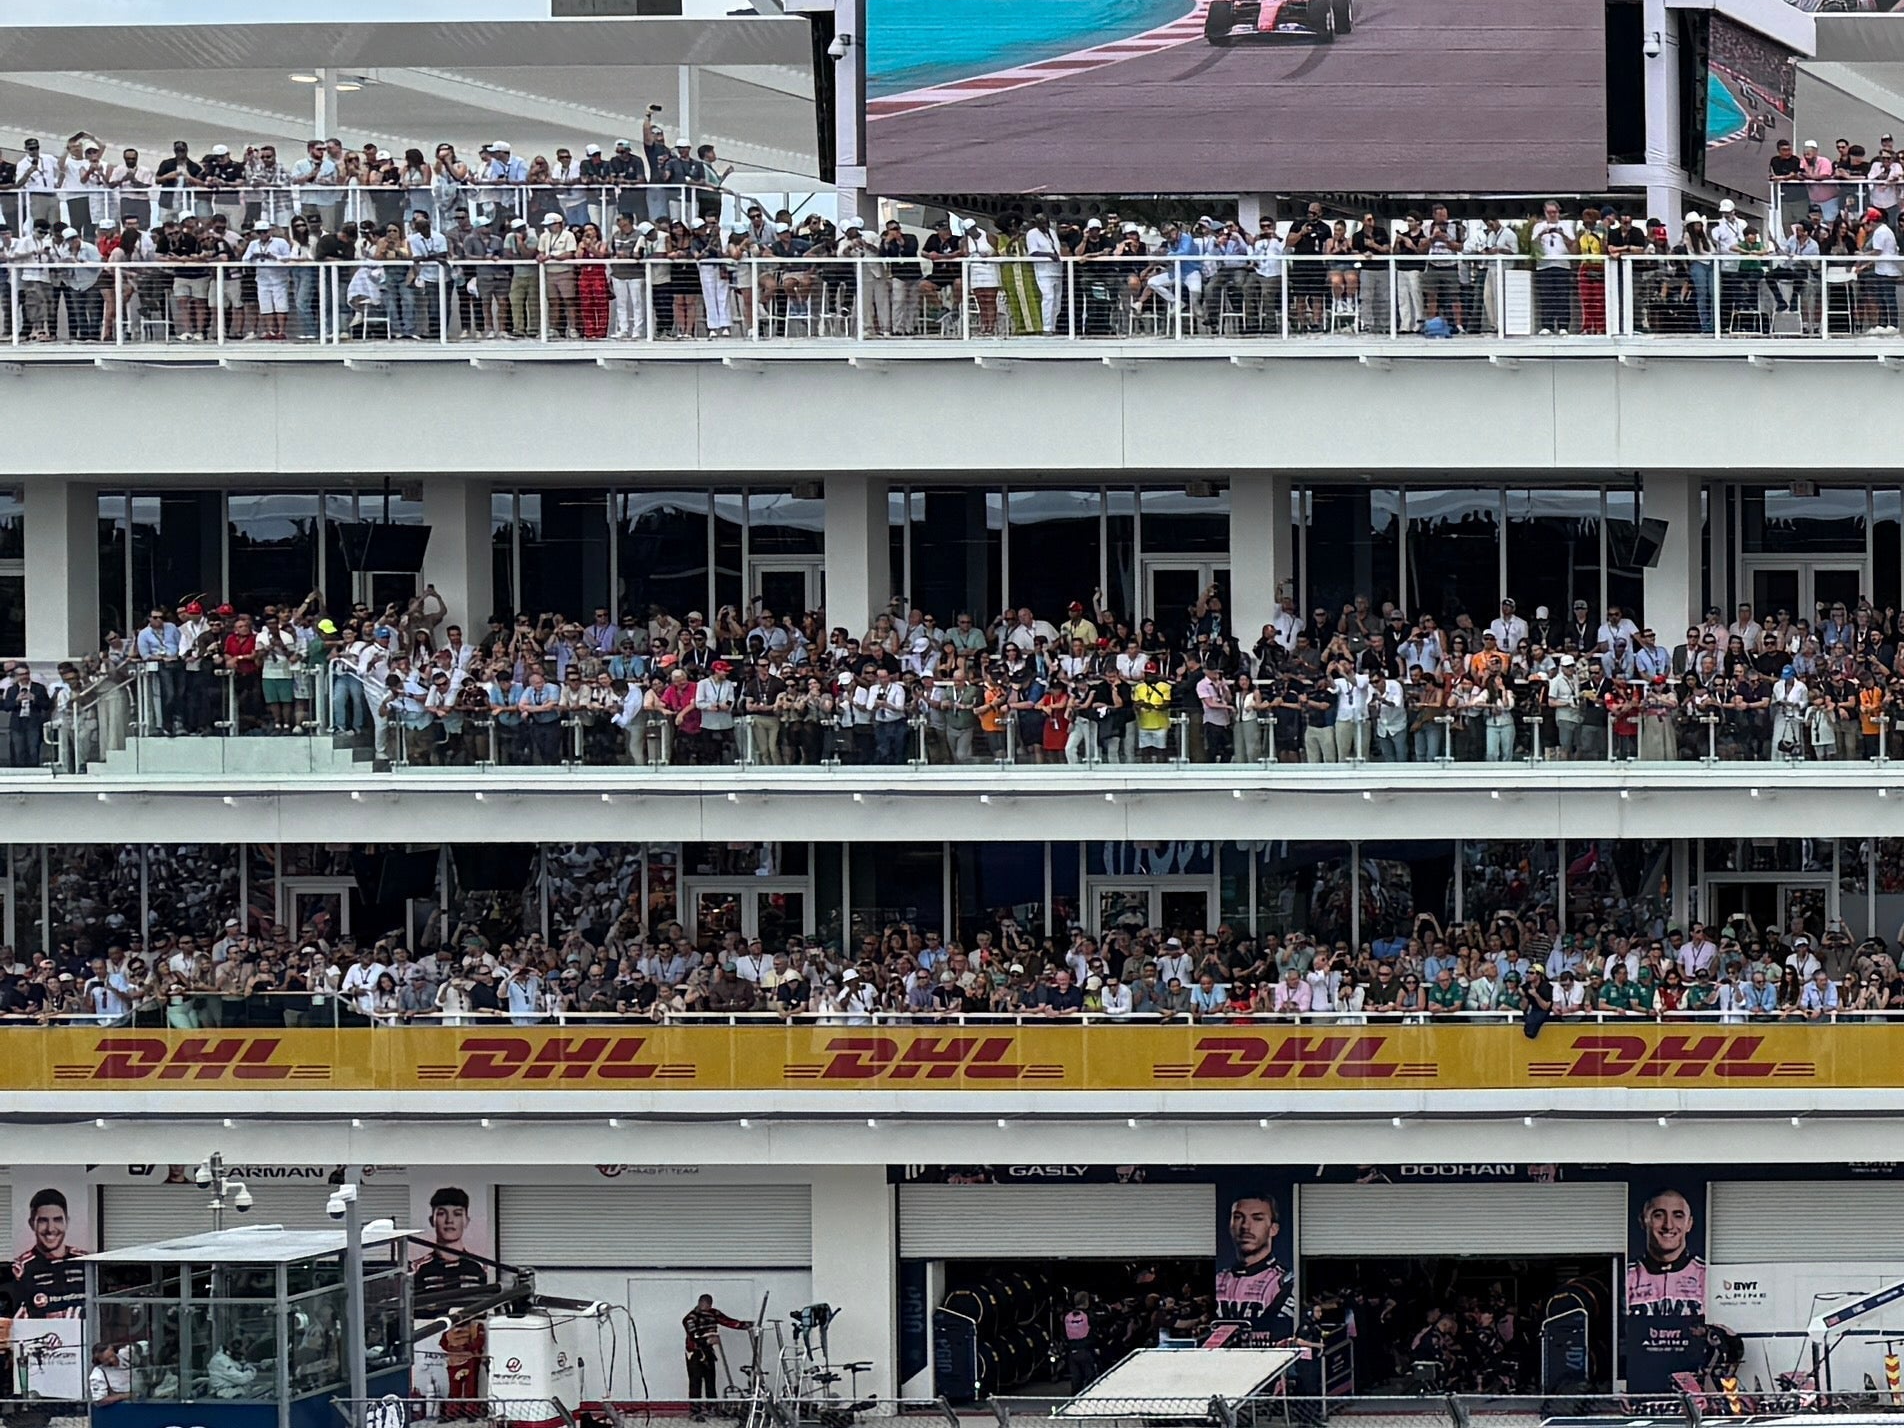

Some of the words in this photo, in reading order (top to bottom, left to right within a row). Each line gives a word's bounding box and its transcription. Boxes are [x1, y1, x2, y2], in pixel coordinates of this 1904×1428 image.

[92, 1039, 294, 1079] DHL
[459, 1038, 656, 1079] DHL
[823, 1038, 1021, 1078] DHL
[1195, 1037, 1396, 1078] DHL
[1570, 1036, 1774, 1077] DHL
[1008, 1165, 1089, 1177] GASLY
[1733, 1280, 1758, 1291] BWT
[1642, 1339, 1689, 1347] ALPINE
[1658, 1329, 1681, 1340] BWT
